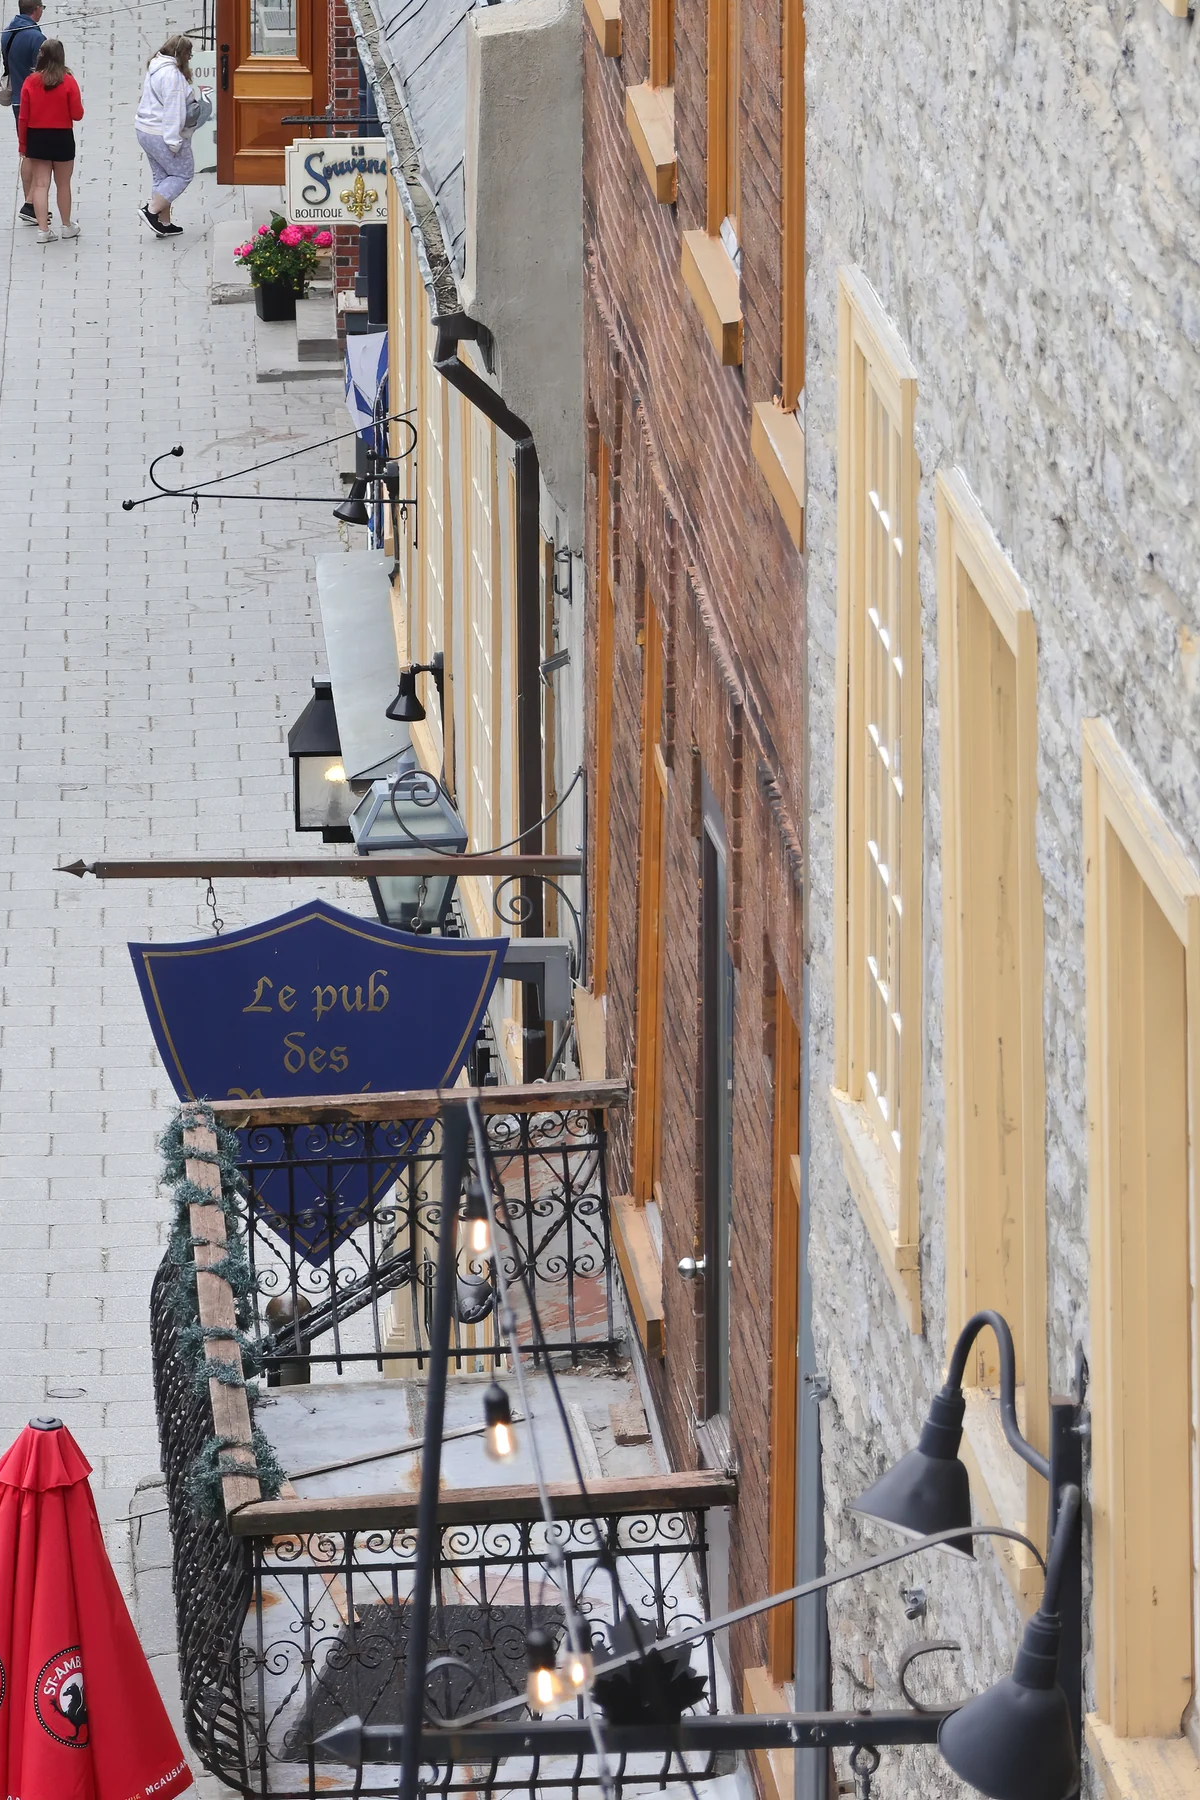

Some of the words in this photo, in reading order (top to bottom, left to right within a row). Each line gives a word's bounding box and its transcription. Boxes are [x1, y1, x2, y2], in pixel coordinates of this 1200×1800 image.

[295, 208, 343, 218] BOUTIQUE
[242, 975, 298, 1013] Le
[311, 969, 390, 1022] pub
[283, 1031, 349, 1074] des
